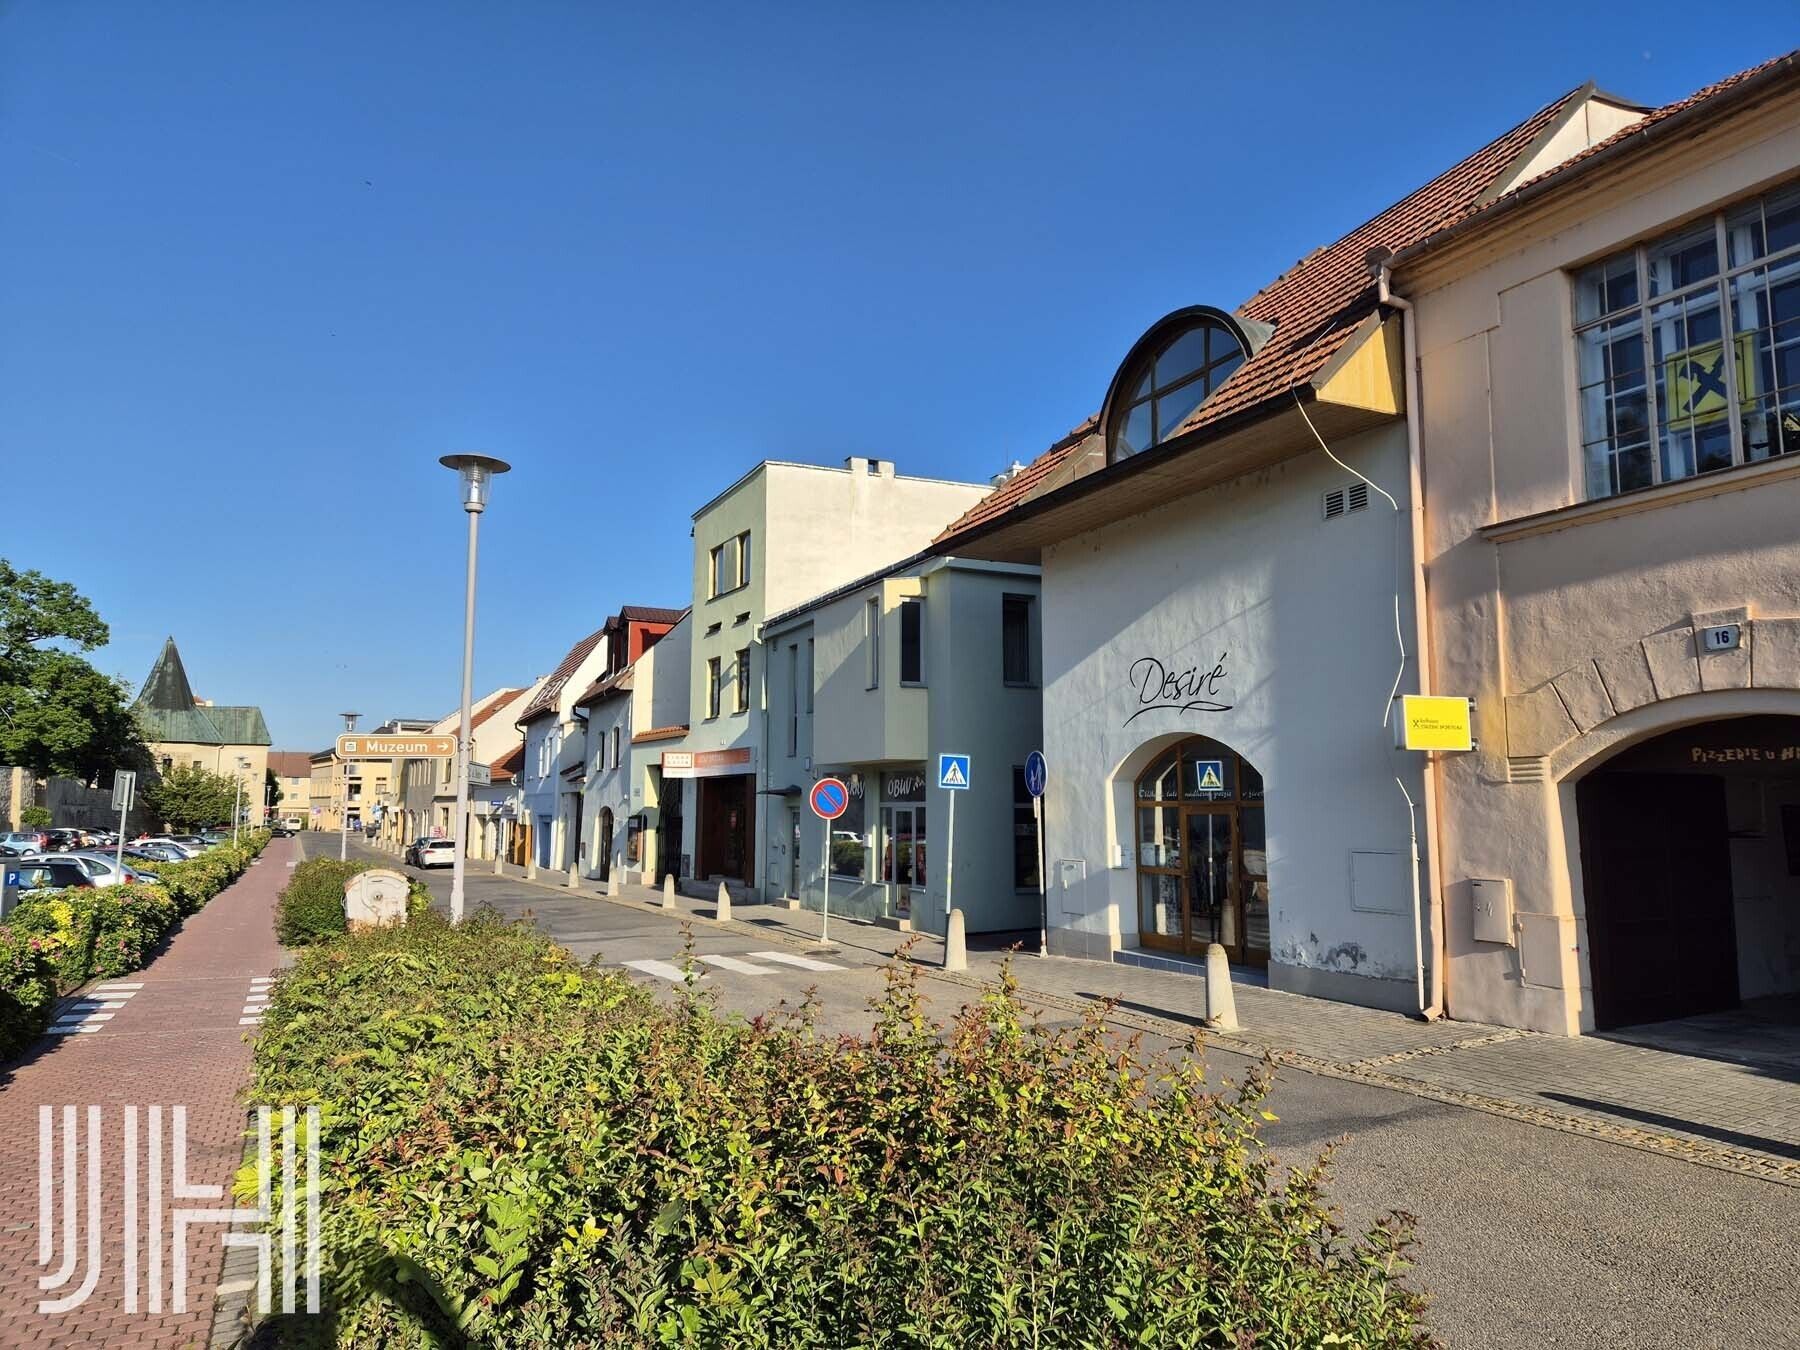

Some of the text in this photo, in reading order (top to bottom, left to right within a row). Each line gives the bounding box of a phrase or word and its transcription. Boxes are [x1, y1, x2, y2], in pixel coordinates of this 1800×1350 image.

[1714, 630, 1729, 645] 16
[1129, 652, 1228, 705] Desiré
[366, 740, 429, 753] Muzeum
